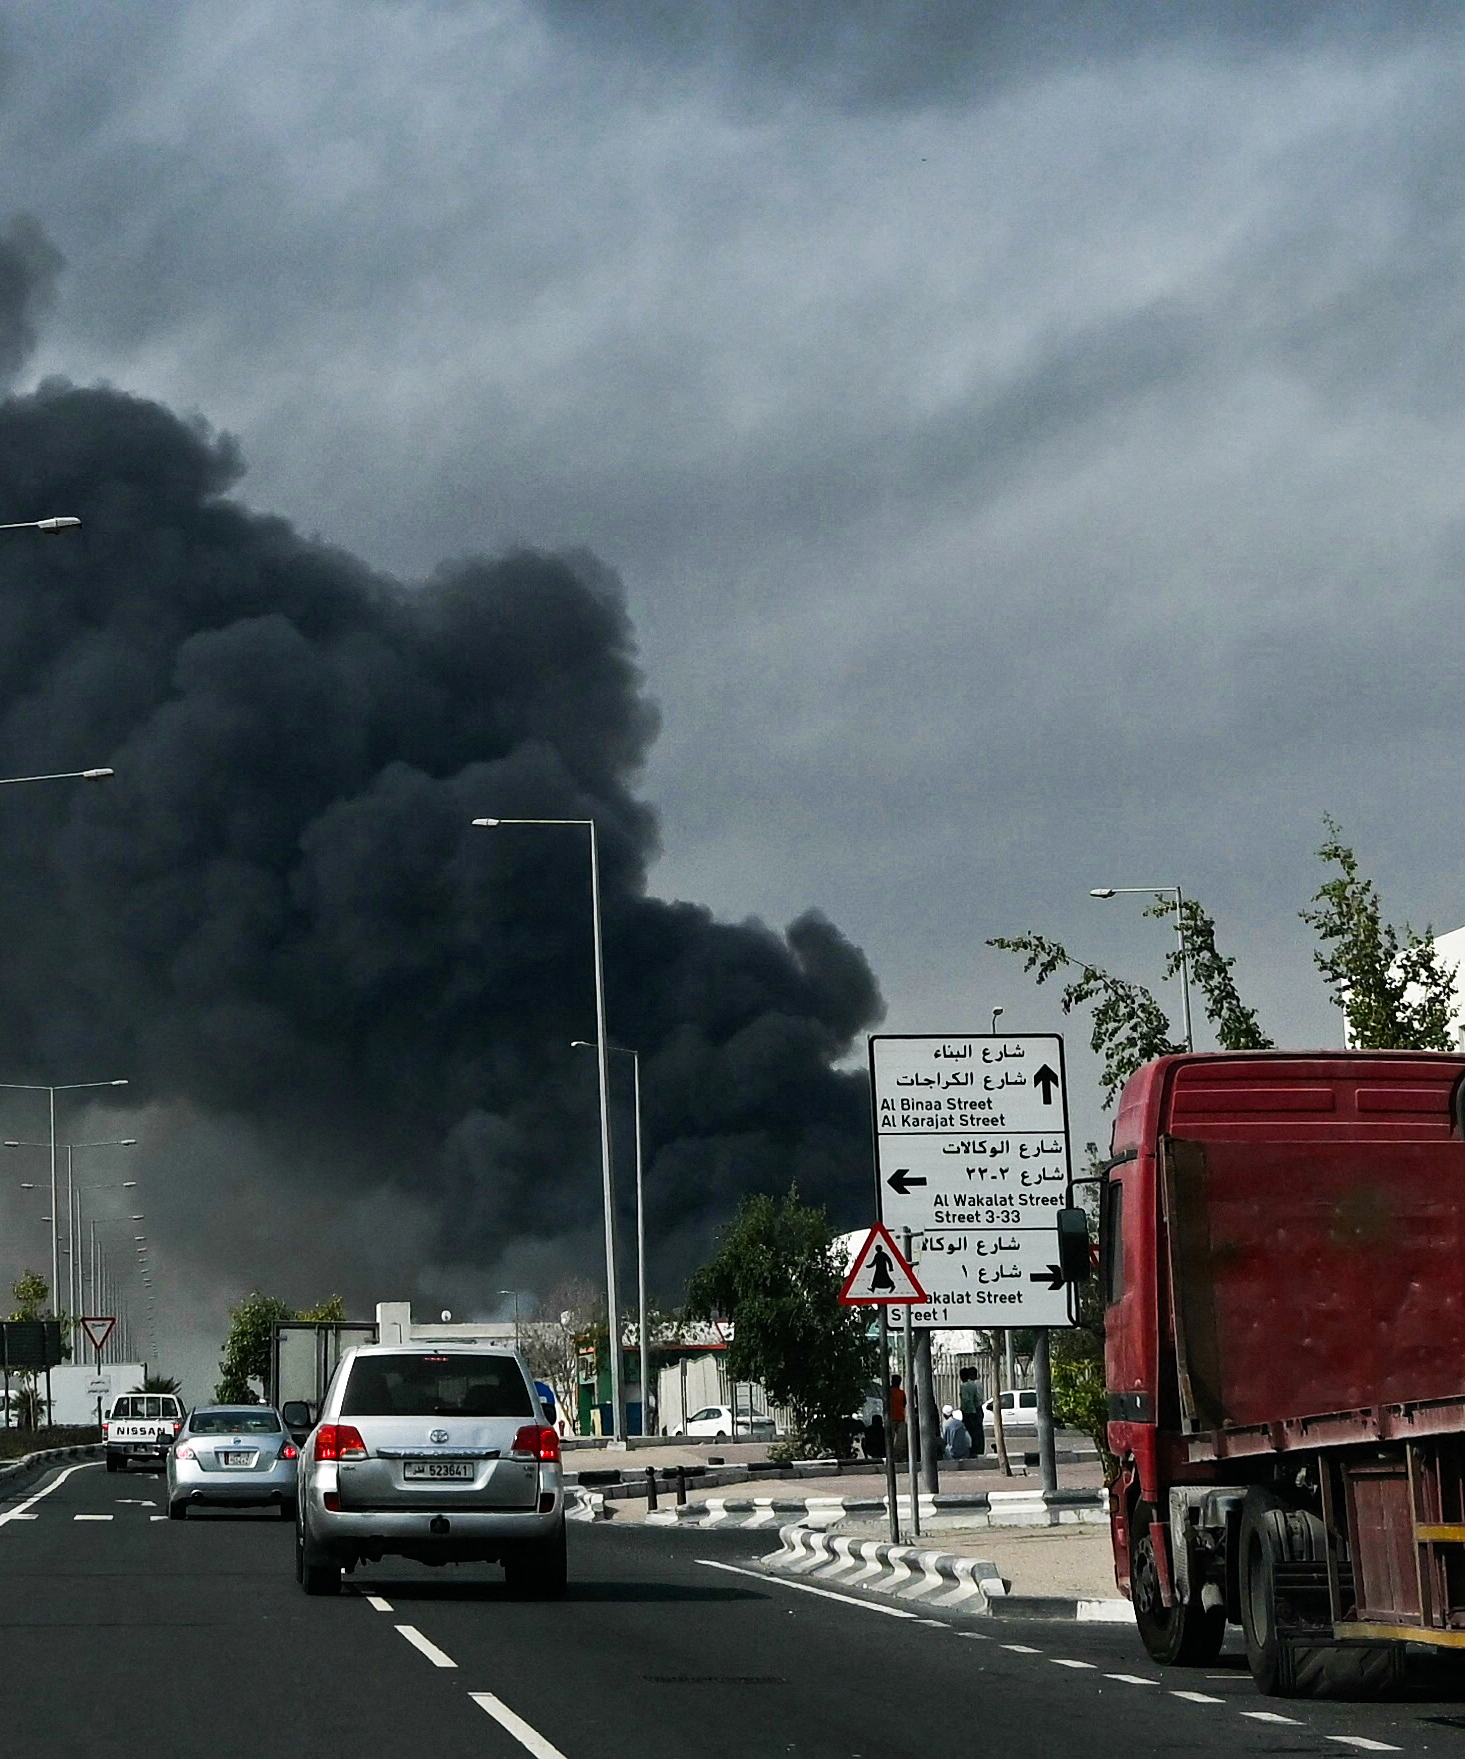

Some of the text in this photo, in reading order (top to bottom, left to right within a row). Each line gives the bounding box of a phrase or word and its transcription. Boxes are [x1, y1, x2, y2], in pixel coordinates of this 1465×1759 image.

[933, 1043, 1025, 1064] شارع البناء
[896, 1071, 1027, 1091] شارع الكراجات
[880, 1097, 993, 1112] Al Binaa Street
[881, 1113, 1006, 1130] Al Karajat Street
[942, 1139, 1063, 1160] شارع الوكالات
[1020, 1166, 1064, 1187] شارع
[933, 1193, 1065, 1207] Al Wakalat Street
[934, 1209, 1021, 1224] Street 3-33
[976, 1236, 1021, 1257] شارع
[961, 1264, 1022, 1285] شارع ١
[976, 1290, 1024, 1304] Street
[942, 1307, 948, 1321] 1
[116, 1426, 166, 1436] NISSAN
[429, 1465, 467, 1476] 523641
